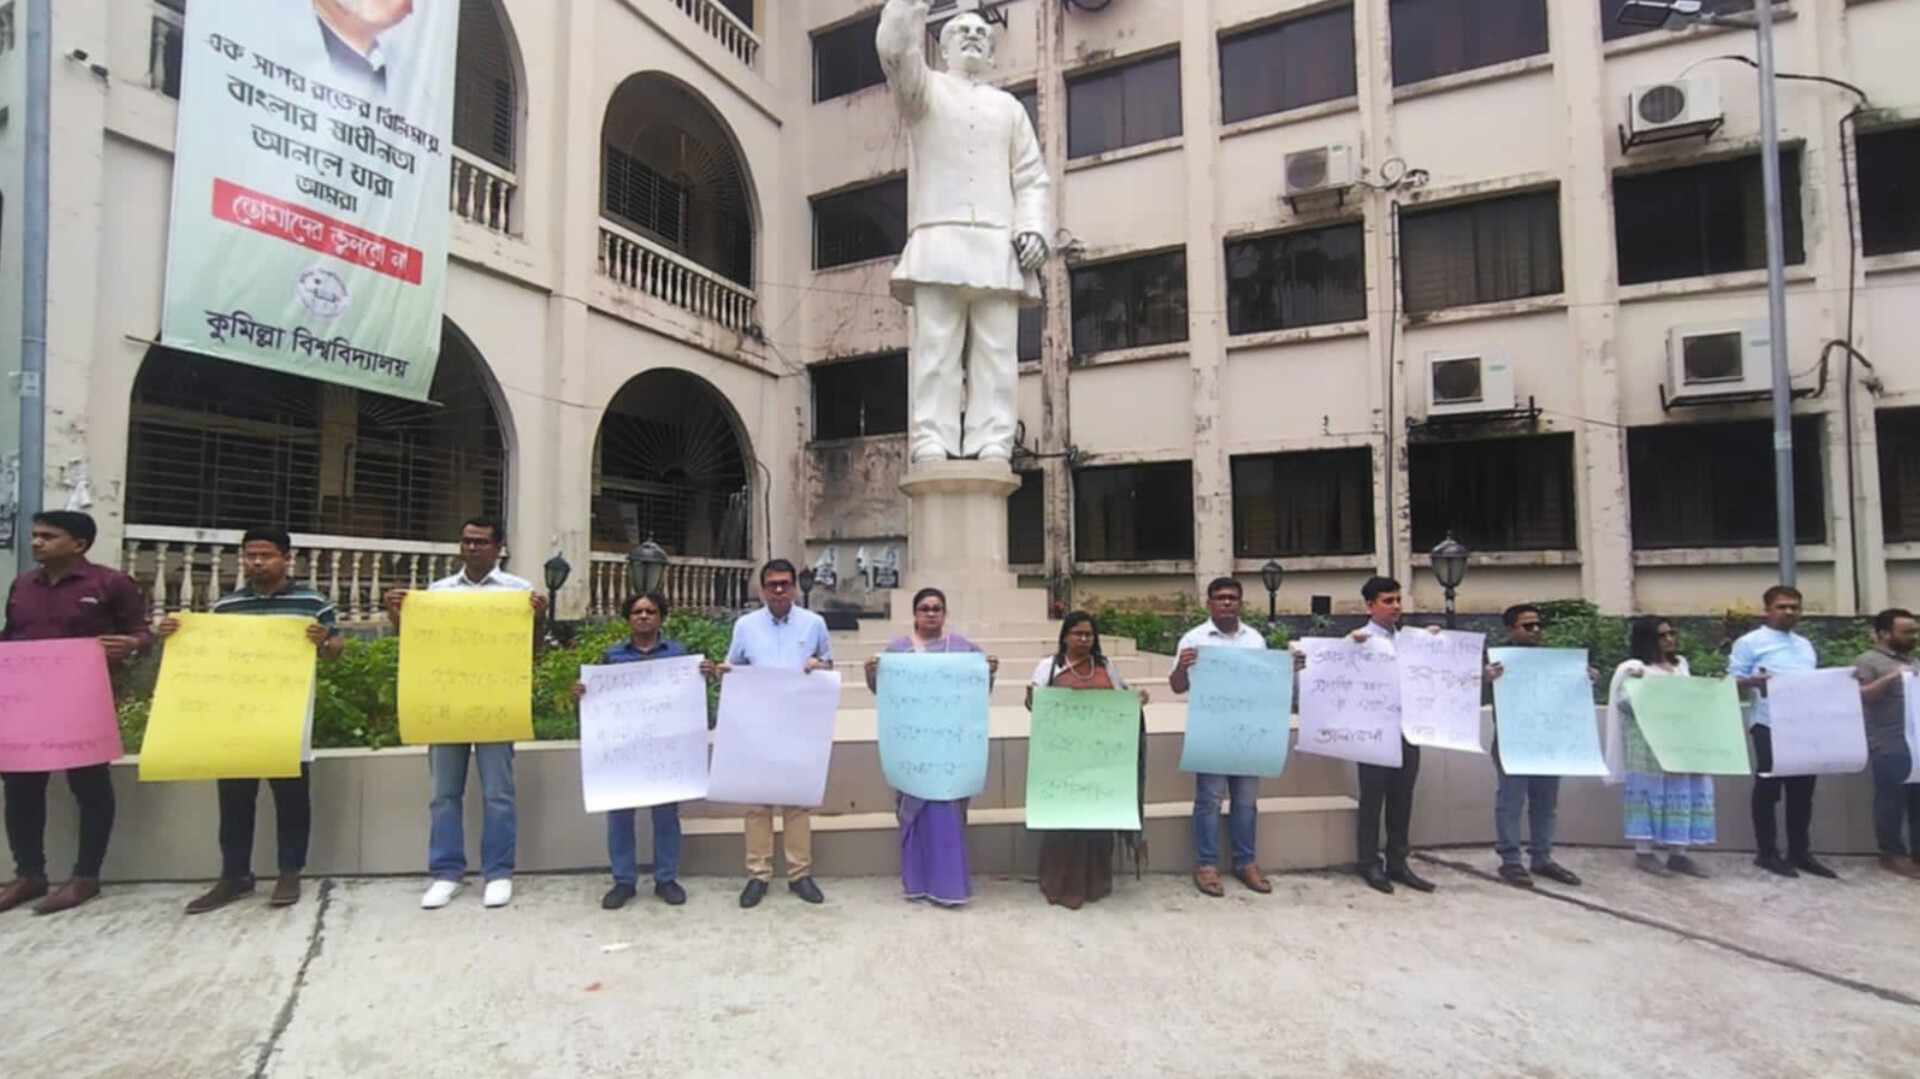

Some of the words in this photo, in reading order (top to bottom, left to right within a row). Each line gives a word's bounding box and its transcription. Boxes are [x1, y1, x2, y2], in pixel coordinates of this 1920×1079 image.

[208, 33, 245, 61] এক
[251, 52, 306, 93] সাগর
[311, 80, 372, 118] রক্তের
[227, 73, 318, 132] বাংলার
[250, 124, 343, 177] আনলে
[350, 162, 394, 198] যারা
[296, 175, 357, 213] আমরা
[232, 195, 325, 242] তোমাদের
[390, 247, 409, 272] না
[204, 310, 286, 349] কুমিল্লা
[292, 327, 410, 378] বিশ্ববিদ্যালয়
